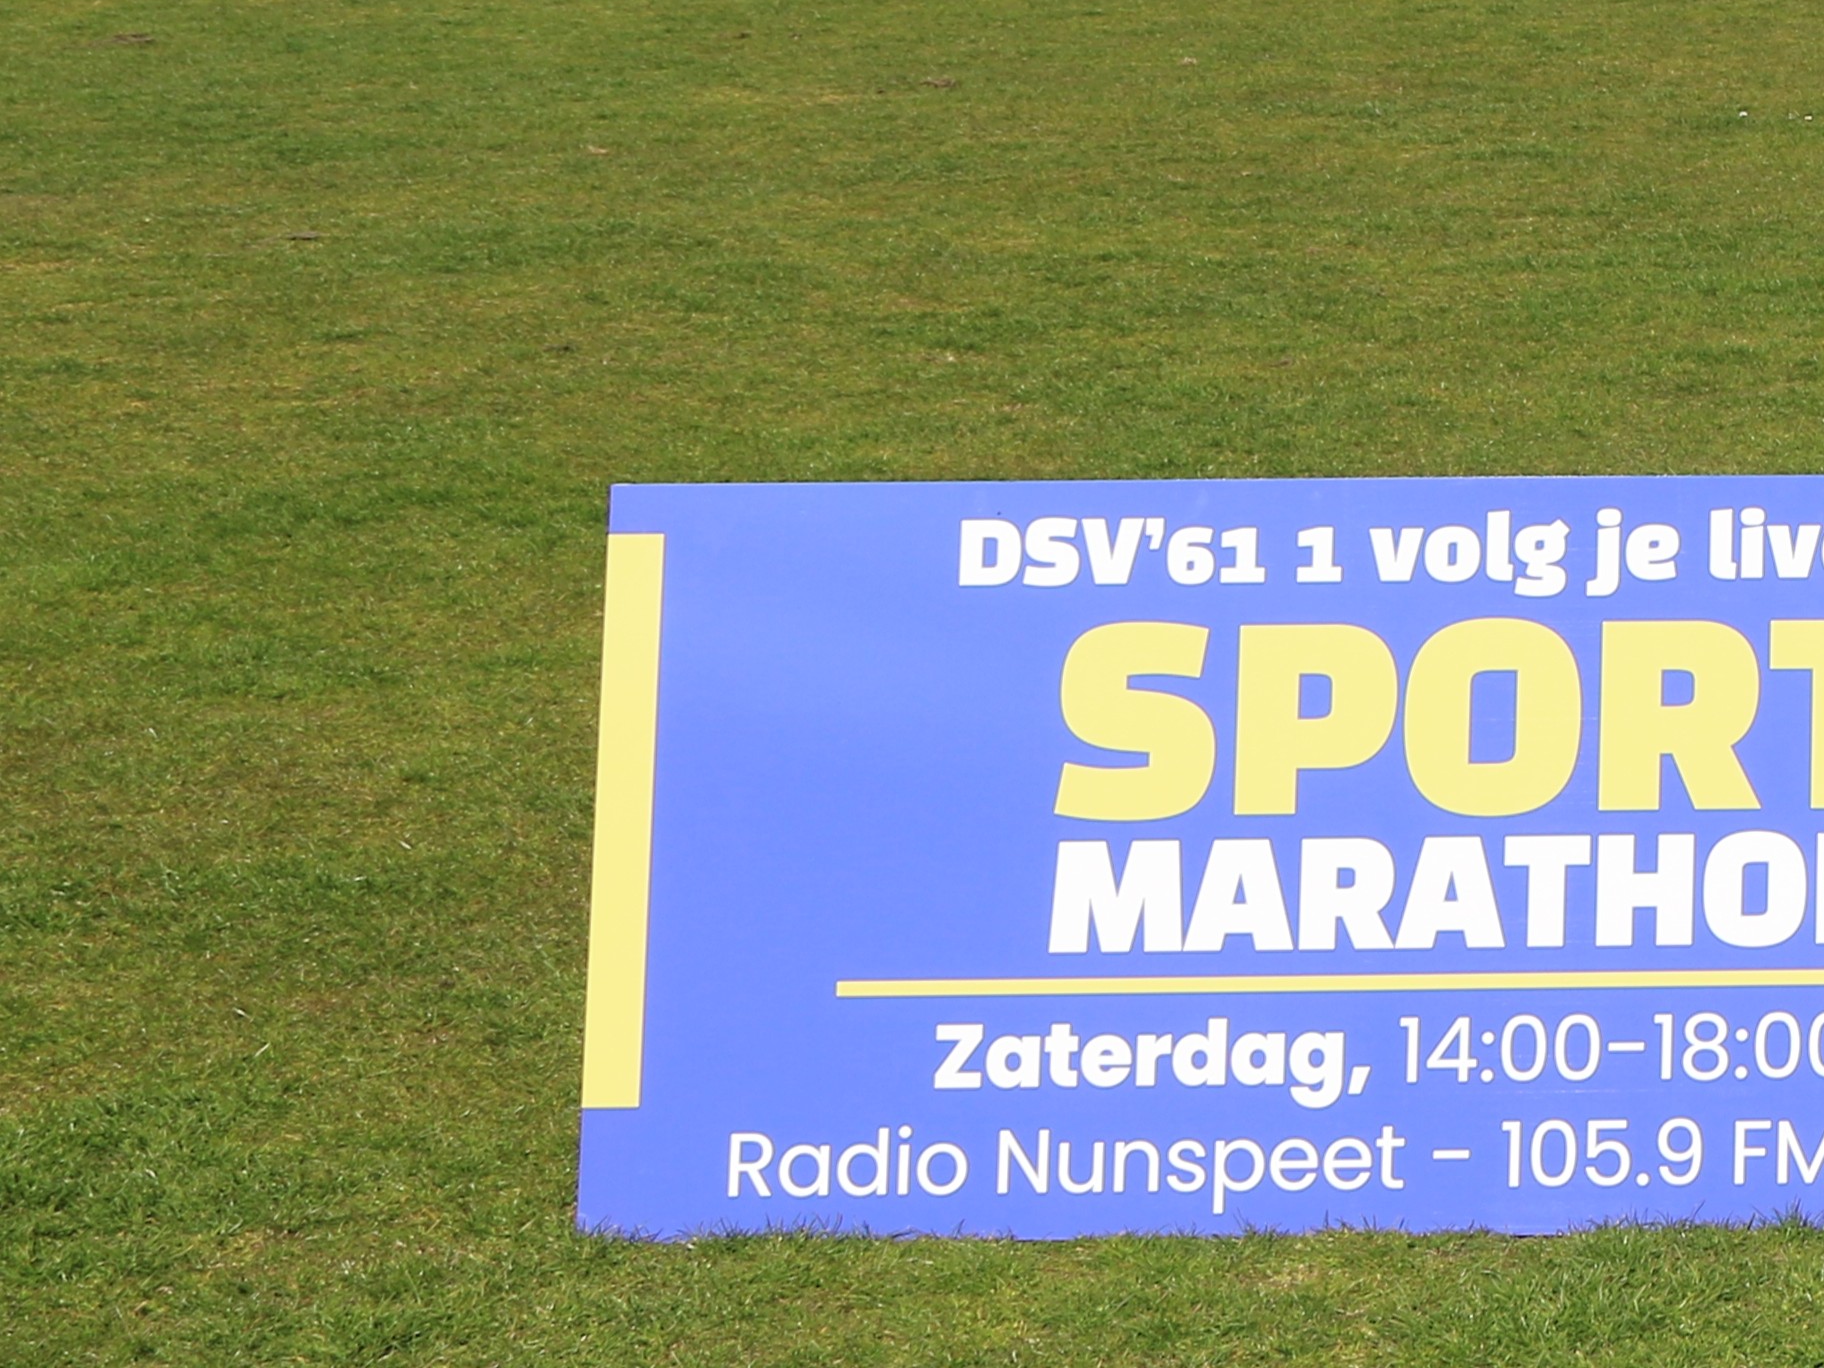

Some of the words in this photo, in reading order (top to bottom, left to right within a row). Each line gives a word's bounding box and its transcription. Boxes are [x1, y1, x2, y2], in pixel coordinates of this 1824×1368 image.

[958, 516, 1266, 587] DSV'61
[1296, 525, 1342, 583] 1
[1369, 509, 1570, 597] volg
[1586, 507, 1680, 597] je
[934, 1017, 1372, 1109] Zaterdag,
[727, 1126, 969, 1197] Radio
[996, 1124, 1406, 1214] Nunspeet
[1502, 1117, 1702, 1188] 105.9
